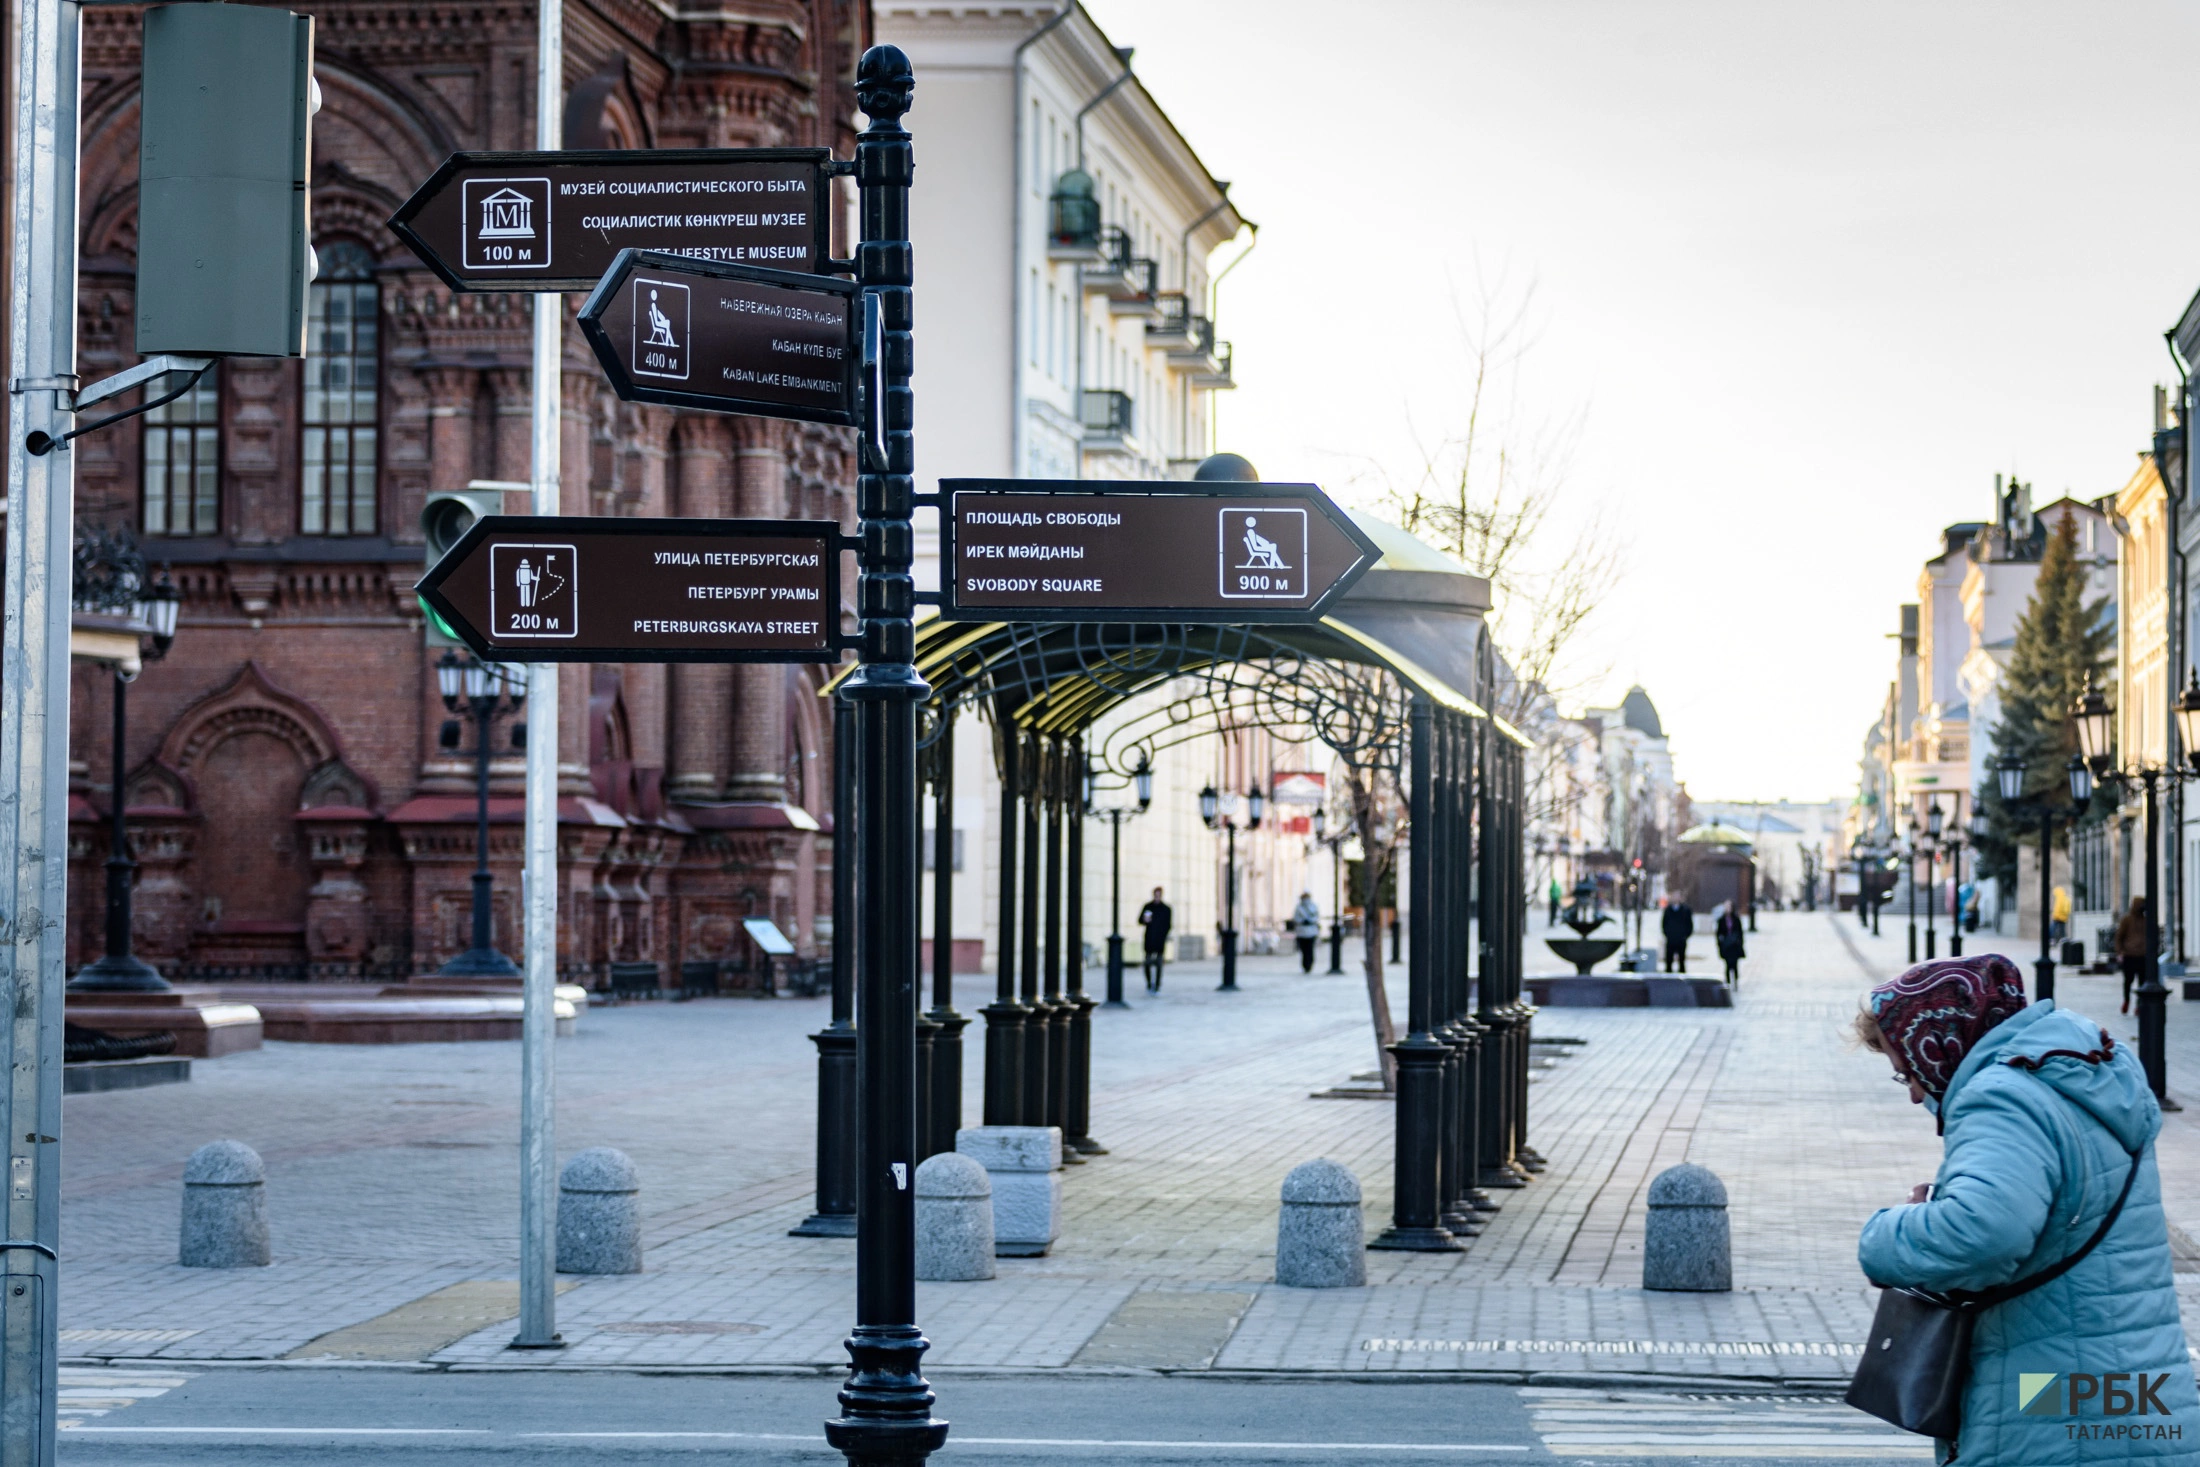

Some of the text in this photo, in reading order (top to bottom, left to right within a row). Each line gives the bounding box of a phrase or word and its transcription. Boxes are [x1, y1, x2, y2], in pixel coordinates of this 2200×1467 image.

[560, 180, 806, 196] МУЗЕЙ СОЦИАЛИСТИЧЕСКОГО БЫТА
[582, 214, 682, 230] СОЦИАЛИСТИК
[762, 213, 807, 226] МУЗЕЕ
[483, 246, 513, 261] 100
[748, 246, 807, 259] MUSEUM
[720, 298, 843, 326] НАБЕРЕЖНАЯ ОЗЕРА КАБАН
[772, 339, 801, 354] КАБАН
[826, 346, 842, 360] БУЕ
[645, 351, 666, 369] 400
[723, 367, 842, 394] KABAN LAKE EMBANKMENT
[966, 512, 1121, 527] ПЛОЩАДЬ СВОБОДЫ
[966, 545, 1005, 558] ИРЕК
[654, 552, 819, 567] УЛИЦА ПЕТЕРБУРГСКАЯ
[967, 578, 1103, 593] SVOBODY SQUARE
[1239, 575, 1270, 591] 900
[688, 586, 819, 601] ПЕТЕРБУРГ УРАМЫ
[510, 613, 541, 629] 200
[634, 620, 819, 635] PETERBURGSKAYA STREET
